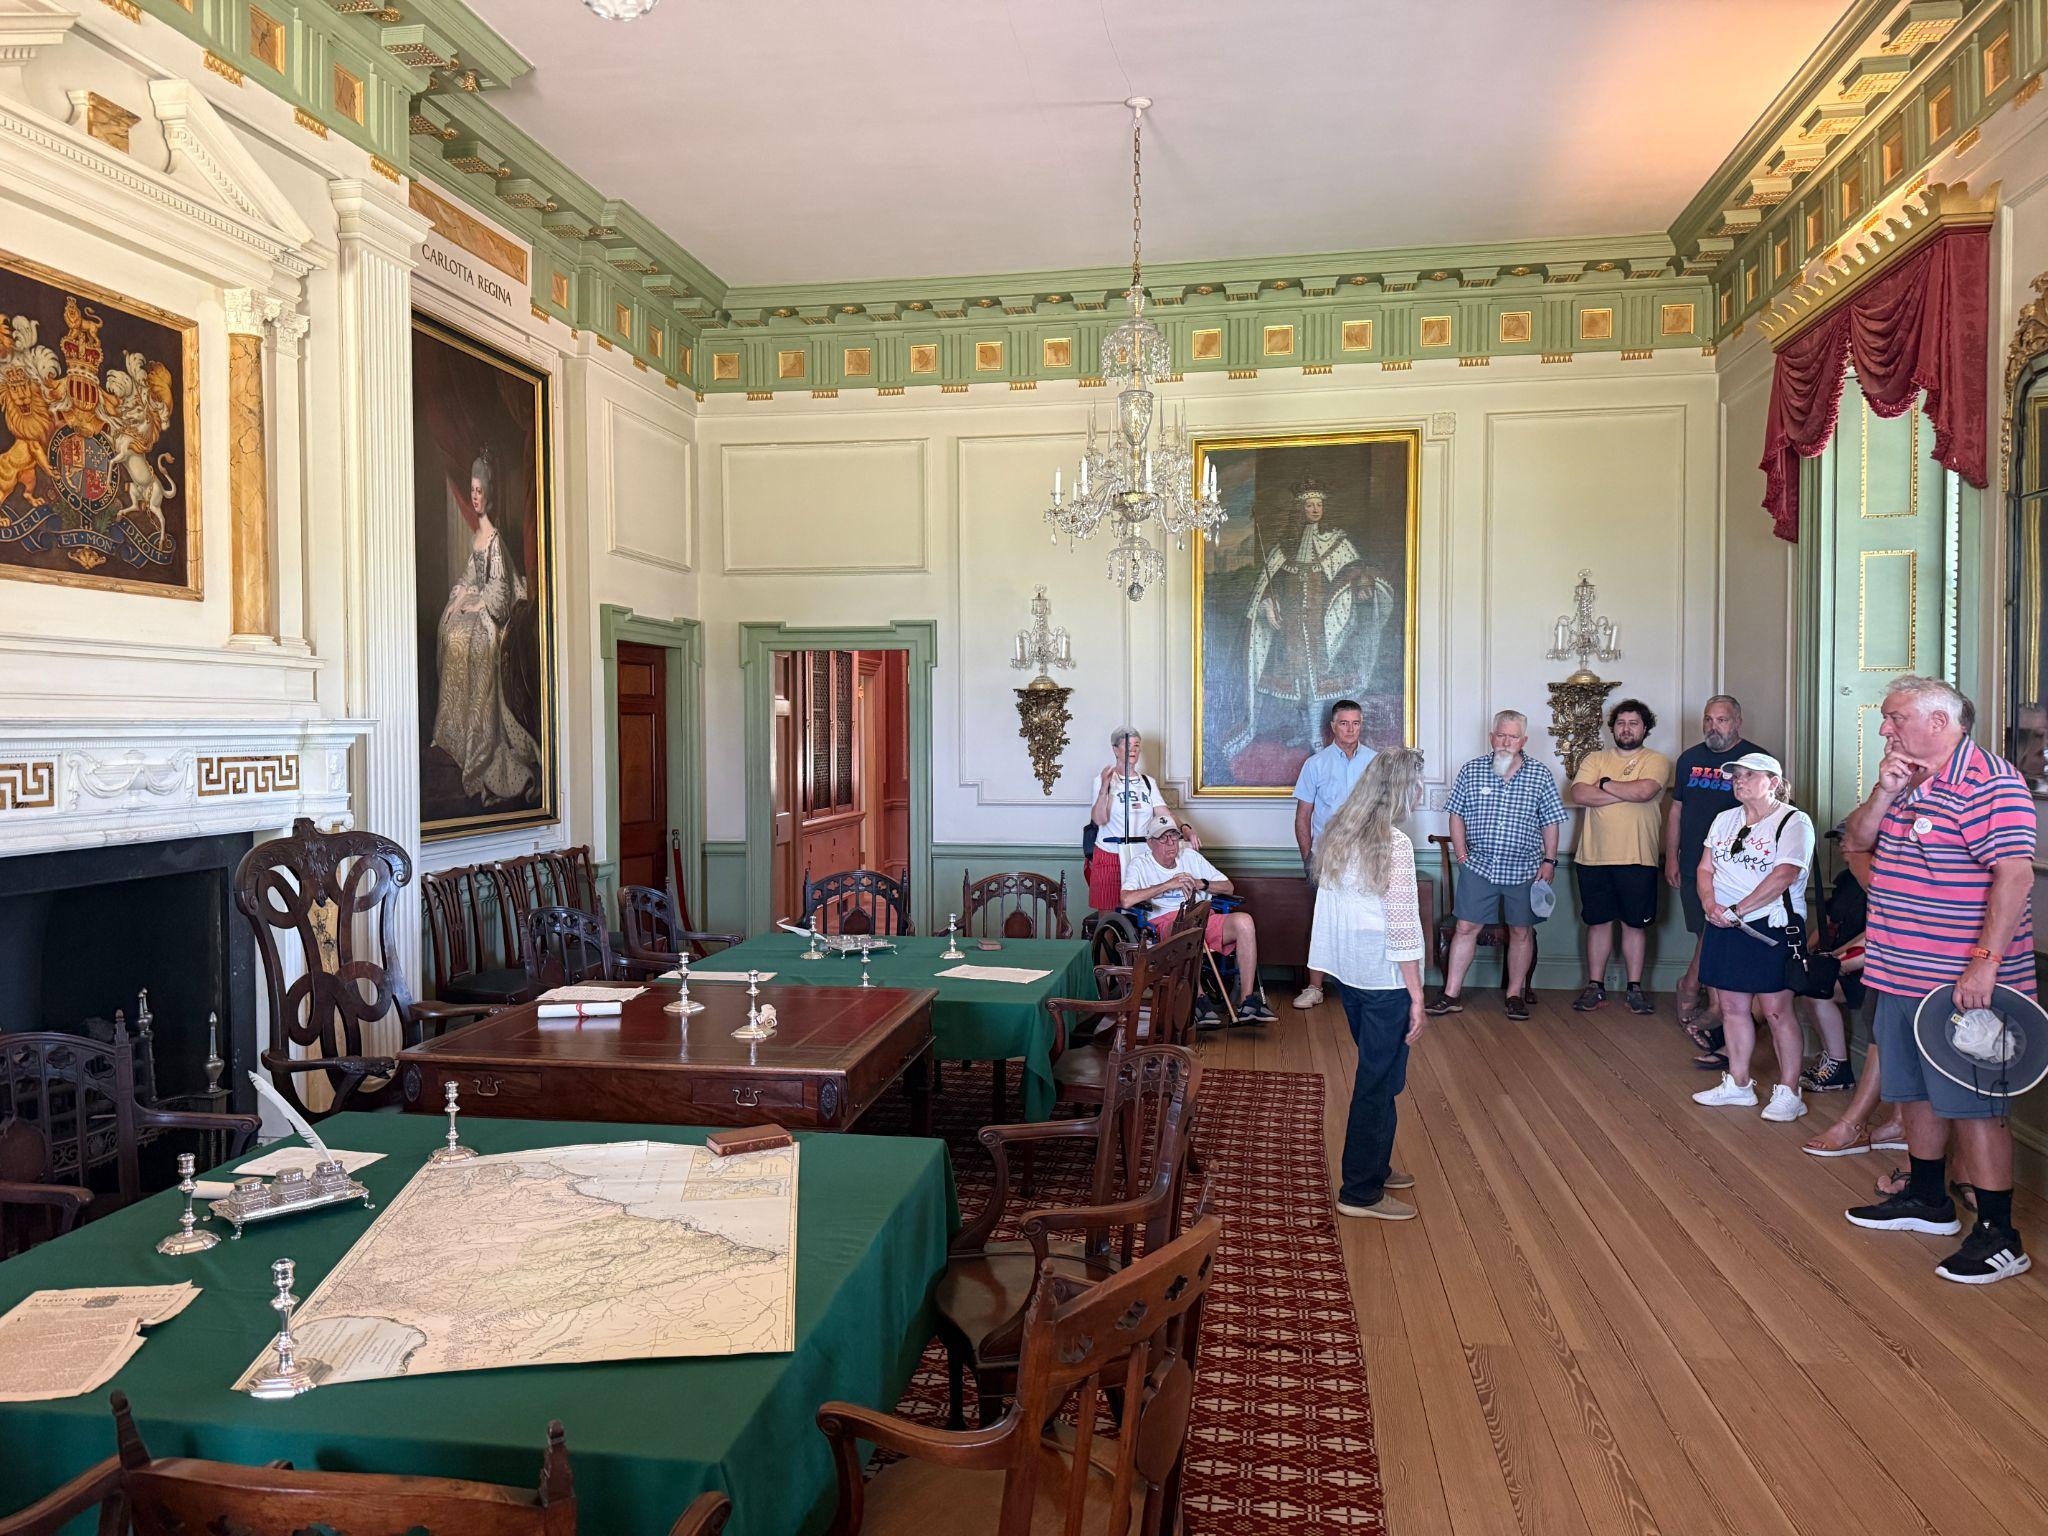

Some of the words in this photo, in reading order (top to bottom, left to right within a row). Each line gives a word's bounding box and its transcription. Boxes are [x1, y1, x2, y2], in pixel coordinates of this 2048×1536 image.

[422, 244, 474, 286] CARLOTTA
[478, 275, 512, 307] REGINA
[51, 431, 66, 453] SOIT
[1, 511, 41, 539] DIEU
[61, 535, 78, 545] ET
[86, 534, 113, 549] MON
[126, 524, 163, 561] DROIT
[1690, 766, 1722, 779] BLU
[1687, 778, 1732, 791] DOGS
